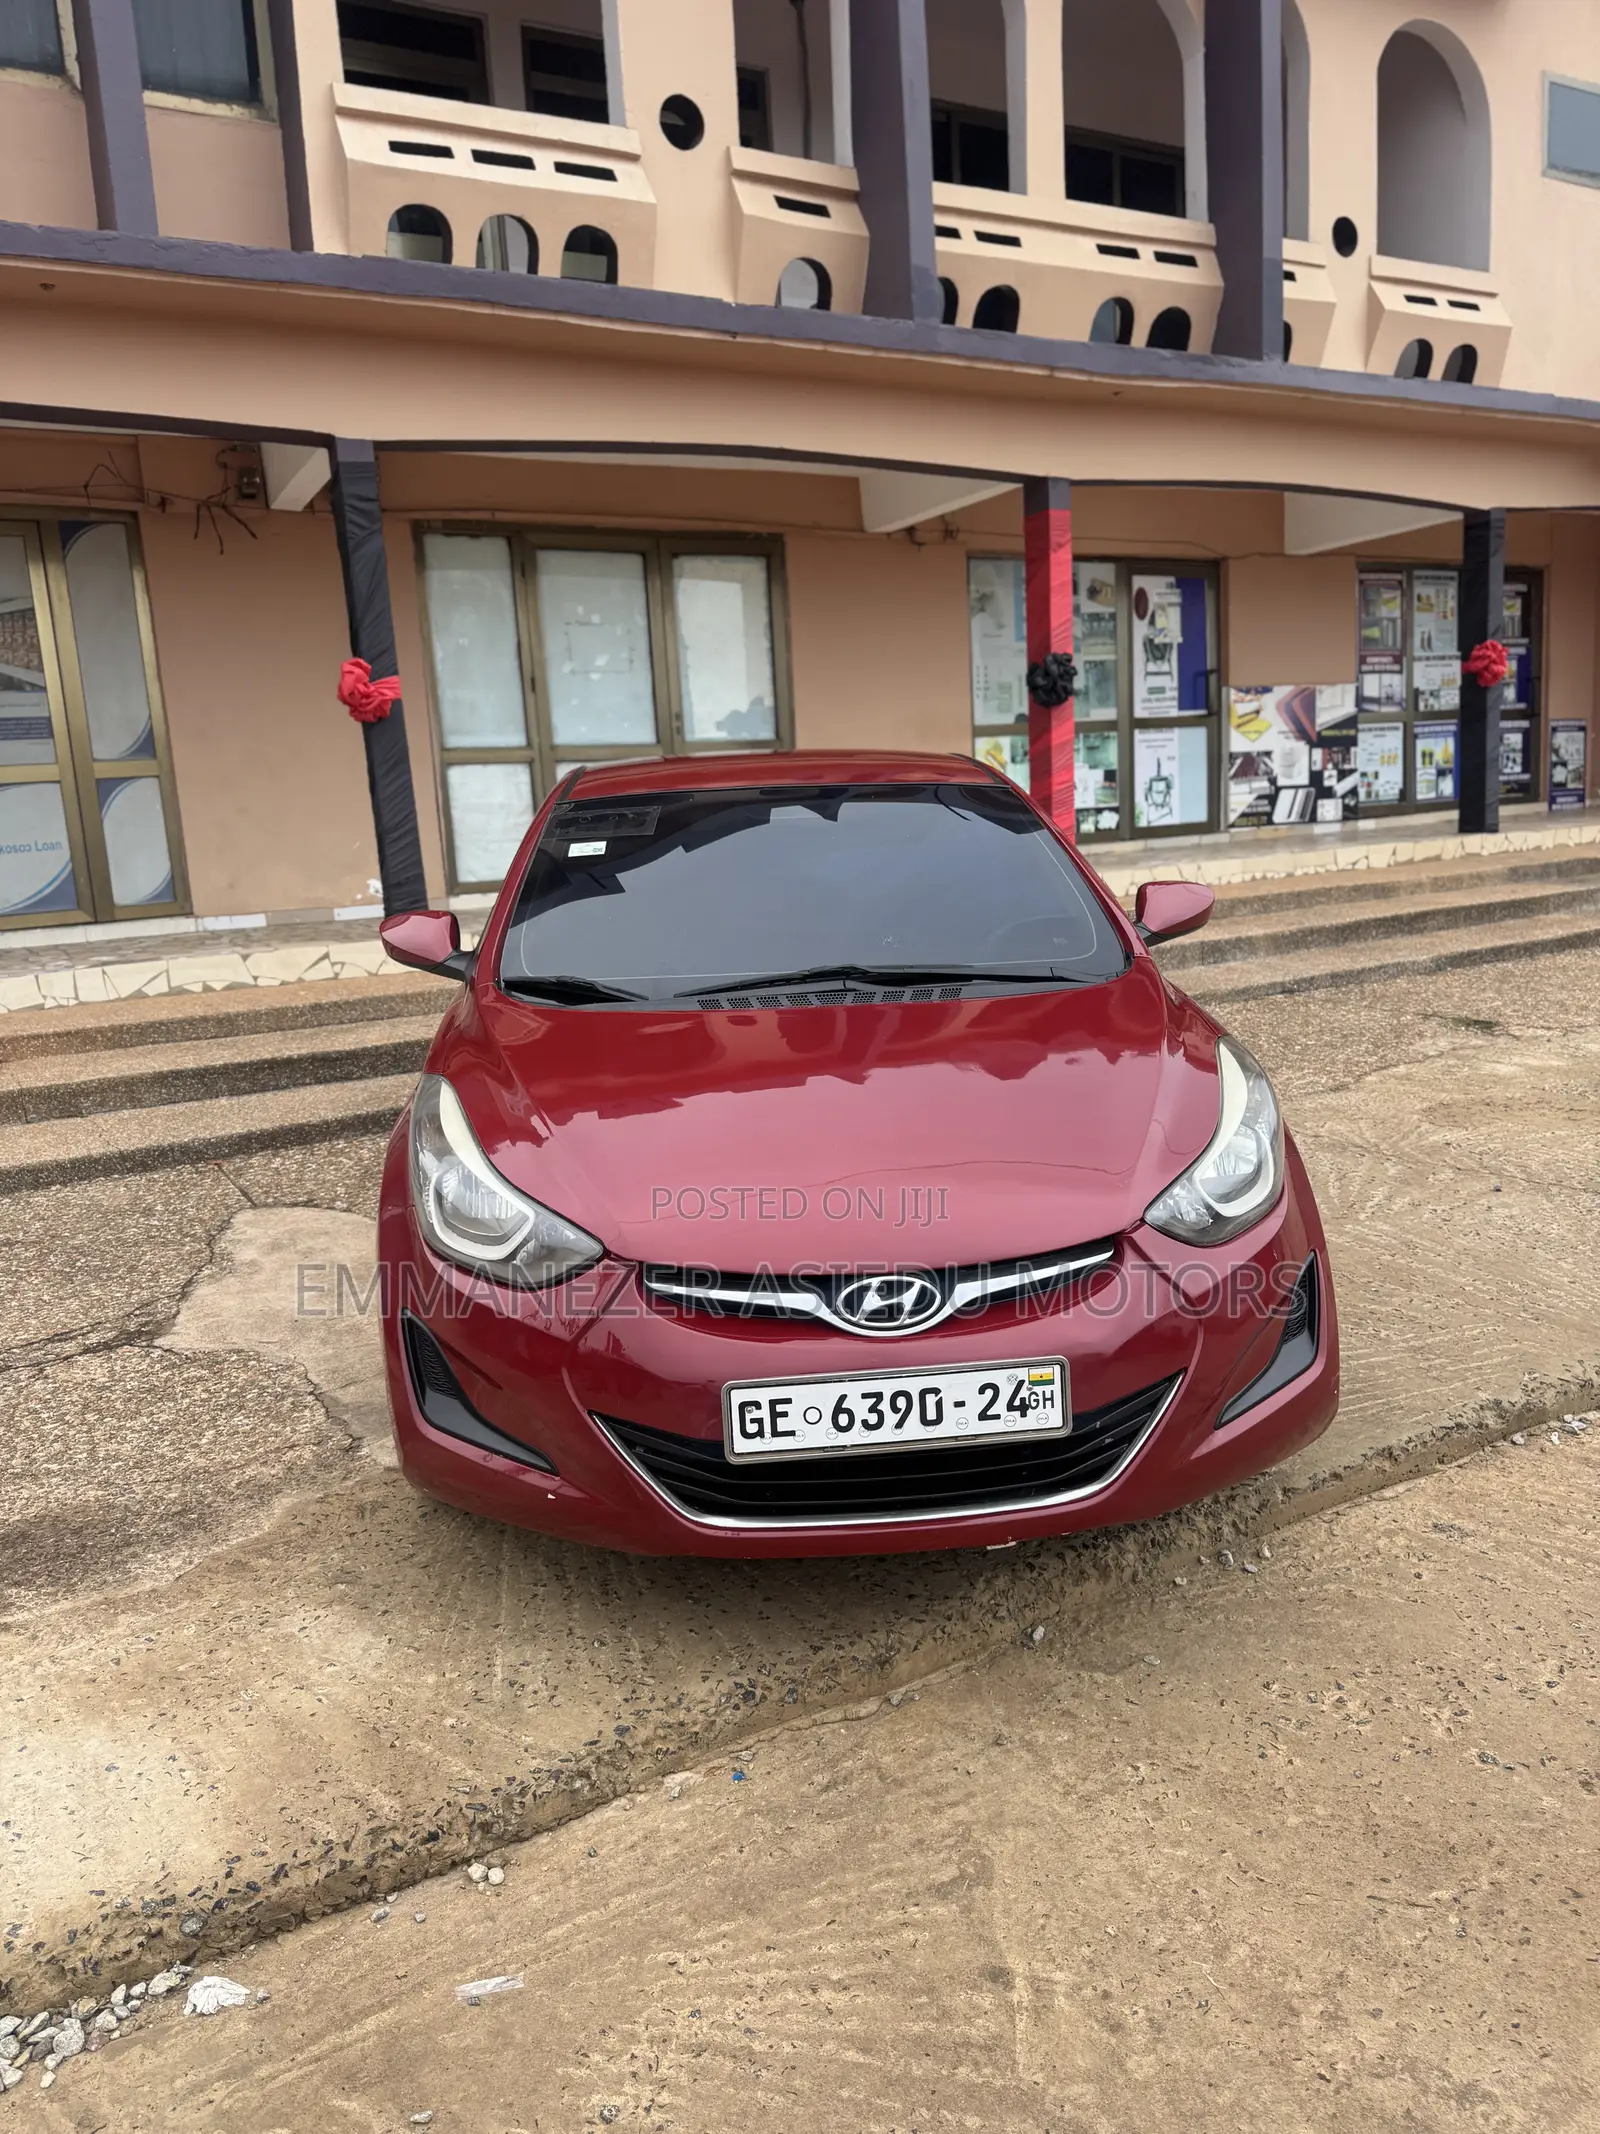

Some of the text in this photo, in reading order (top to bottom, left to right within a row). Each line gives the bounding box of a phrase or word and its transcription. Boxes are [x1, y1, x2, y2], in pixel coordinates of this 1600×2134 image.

[34, 839, 63, 852] Loan
[1028, 1389, 1055, 1410] GH
[738, 1397, 796, 1439] GE
